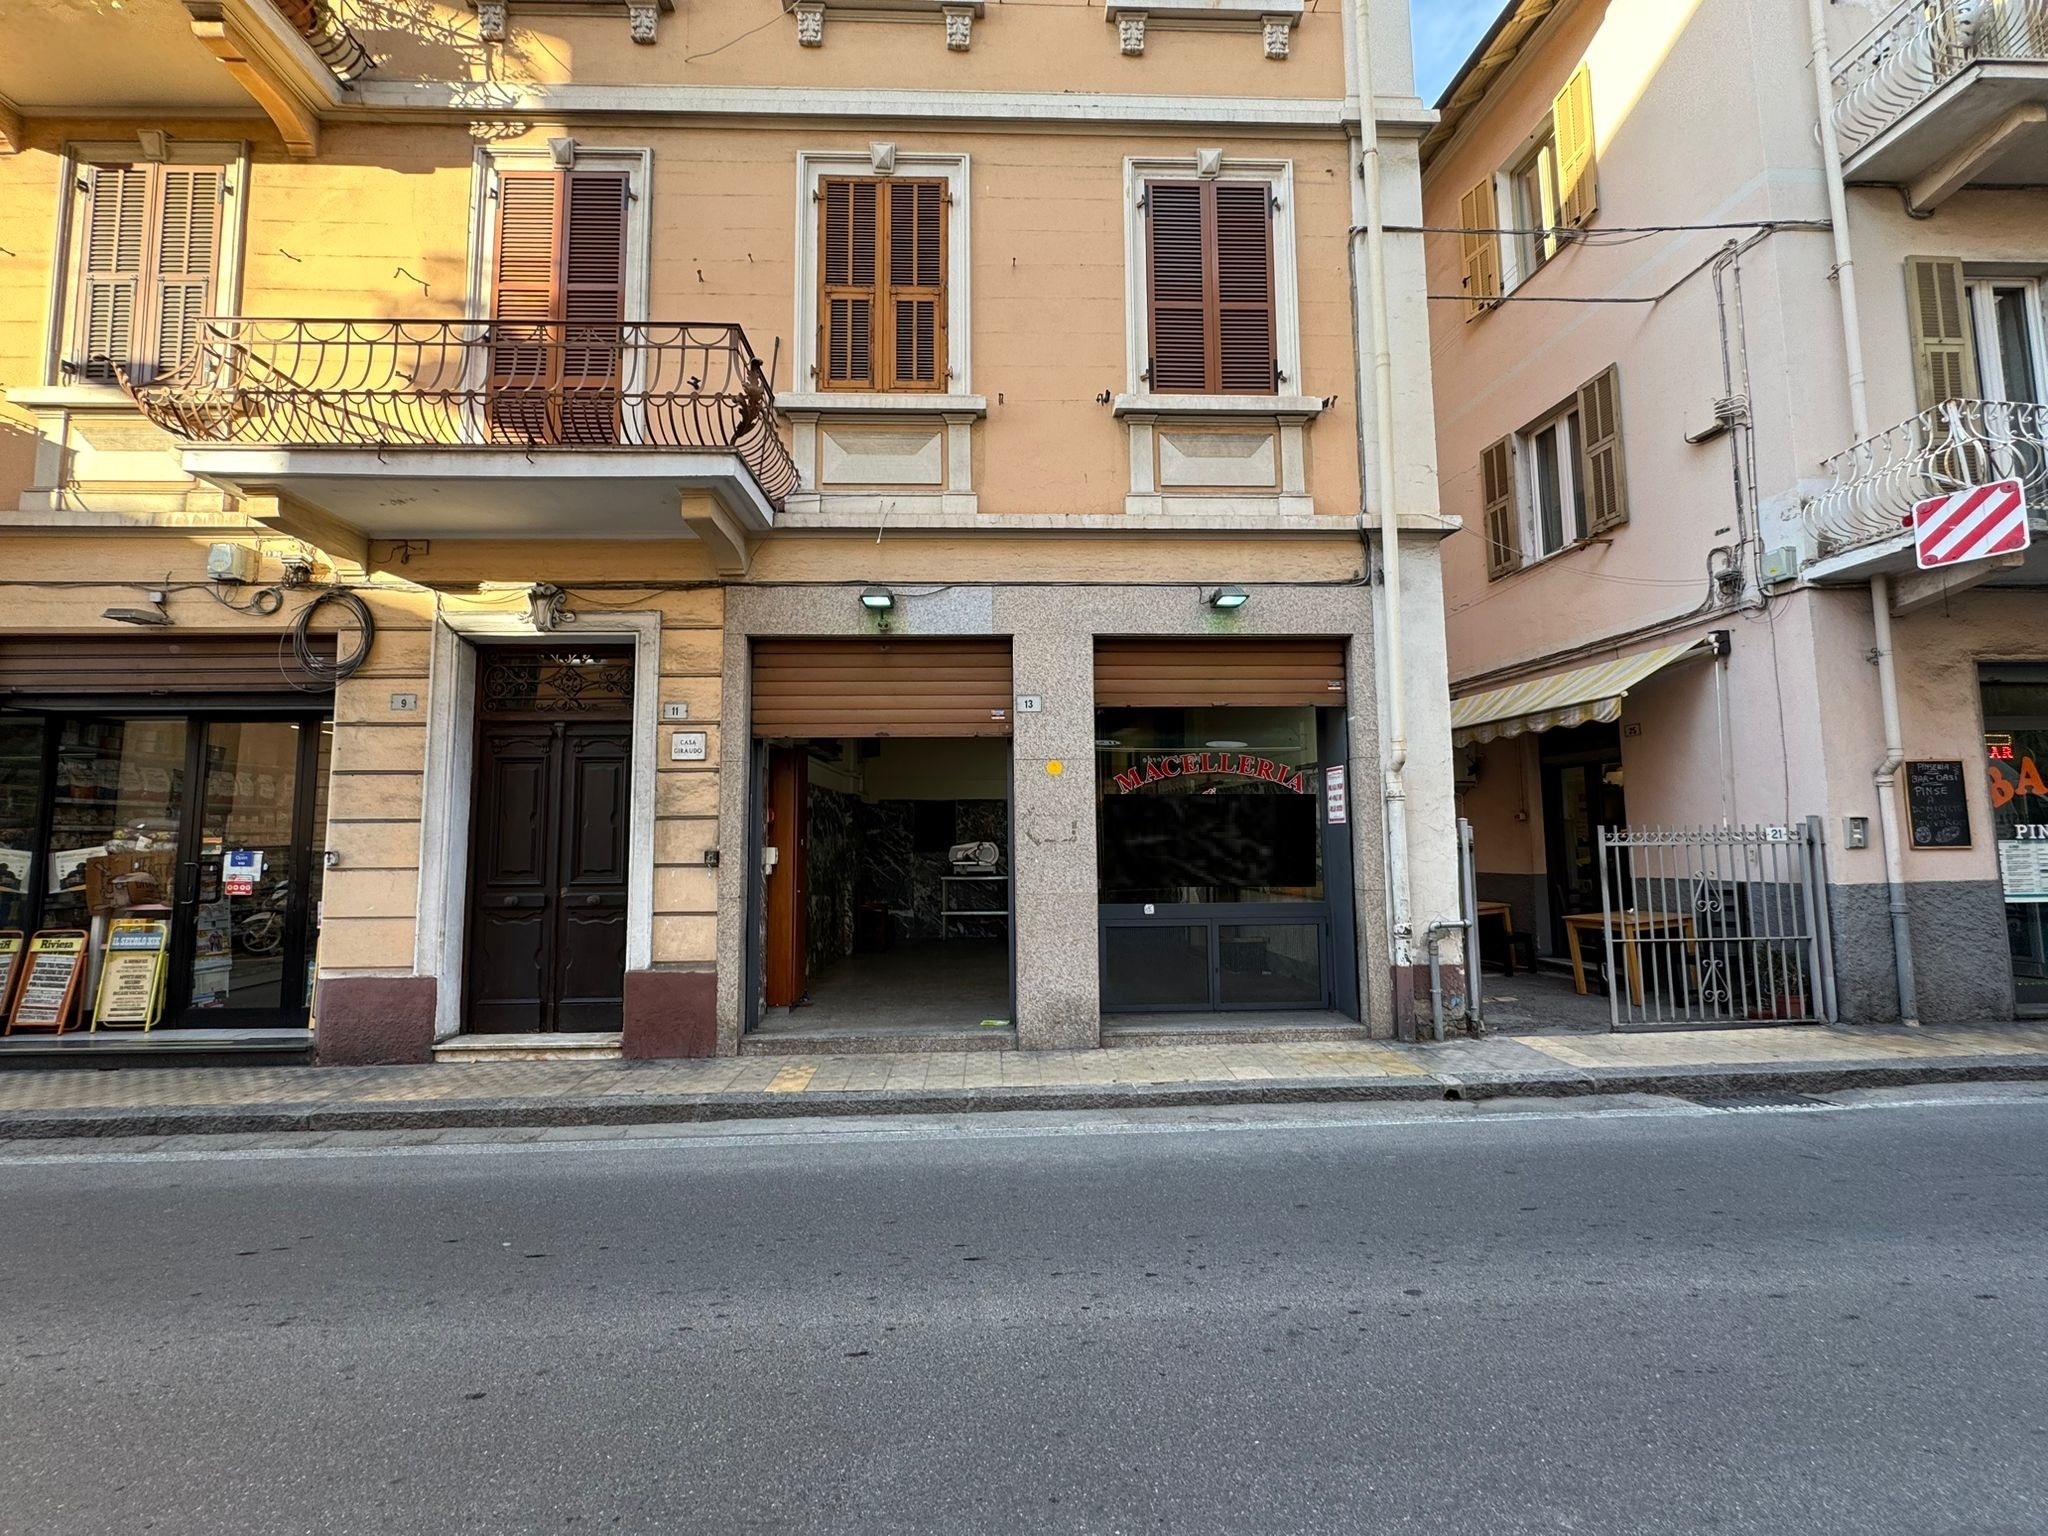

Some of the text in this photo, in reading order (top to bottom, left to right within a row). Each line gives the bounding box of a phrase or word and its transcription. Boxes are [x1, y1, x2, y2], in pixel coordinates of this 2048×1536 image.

[401, 698, 407, 708] 9
[1024, 699, 1034, 709] 13
[672, 706, 679, 716] 11
[1113, 752, 1306, 794] MACELLERIA
[1914, 786, 1948, 797] PINSE
[1771, 829, 1783, 839] 21
[40, 939, 74, 949] Riviera
[120, 936, 146, 946] SECOLO
